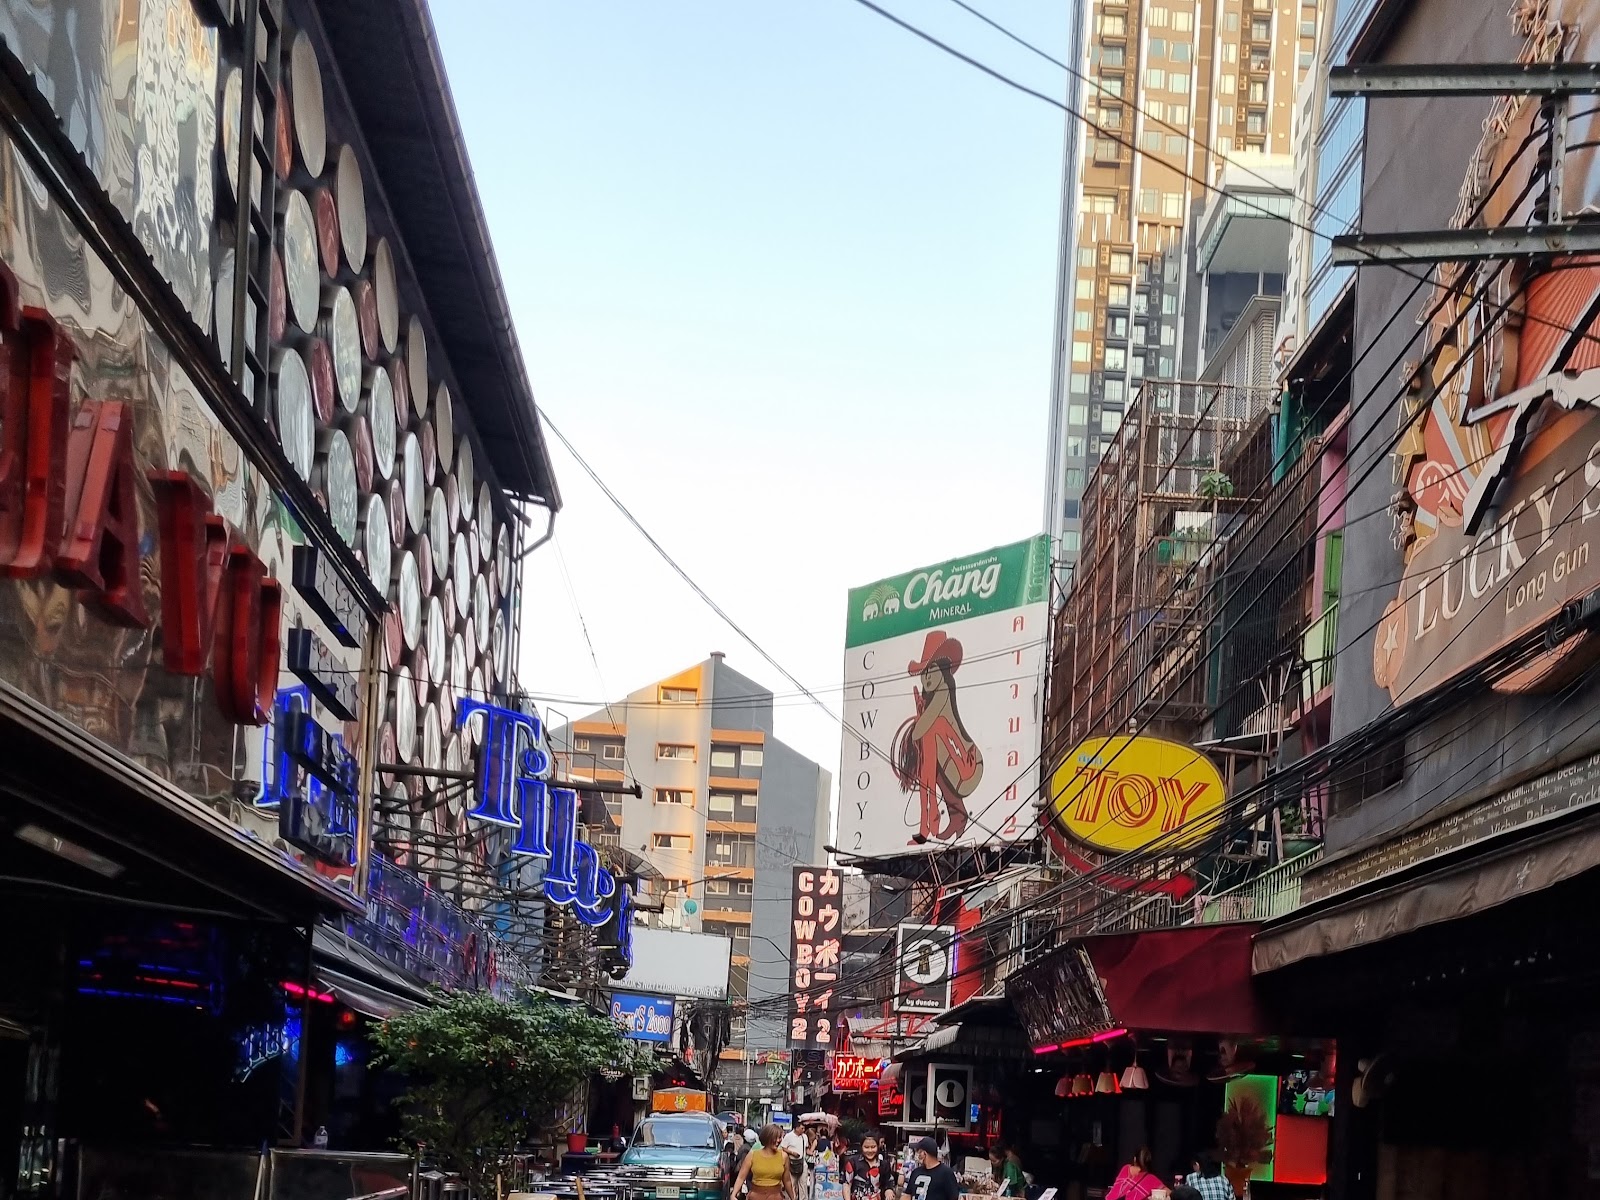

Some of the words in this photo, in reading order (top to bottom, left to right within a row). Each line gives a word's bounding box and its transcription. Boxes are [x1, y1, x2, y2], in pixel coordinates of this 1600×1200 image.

[1414, 468, 1567, 642] LUCKY
[903, 563, 1002, 610] Chang
[1504, 568, 1547, 616] Long
[1552, 541, 1589, 583] Gun
[928, 602, 972, 621] MINERAL
[1073, 766, 1211, 834] TOY
[646, 1005, 671, 1035] 2000
[905, 998, 915, 1007] by
[915, 998, 939, 1007] dundee
[913, 1175, 932, 1200] 3
